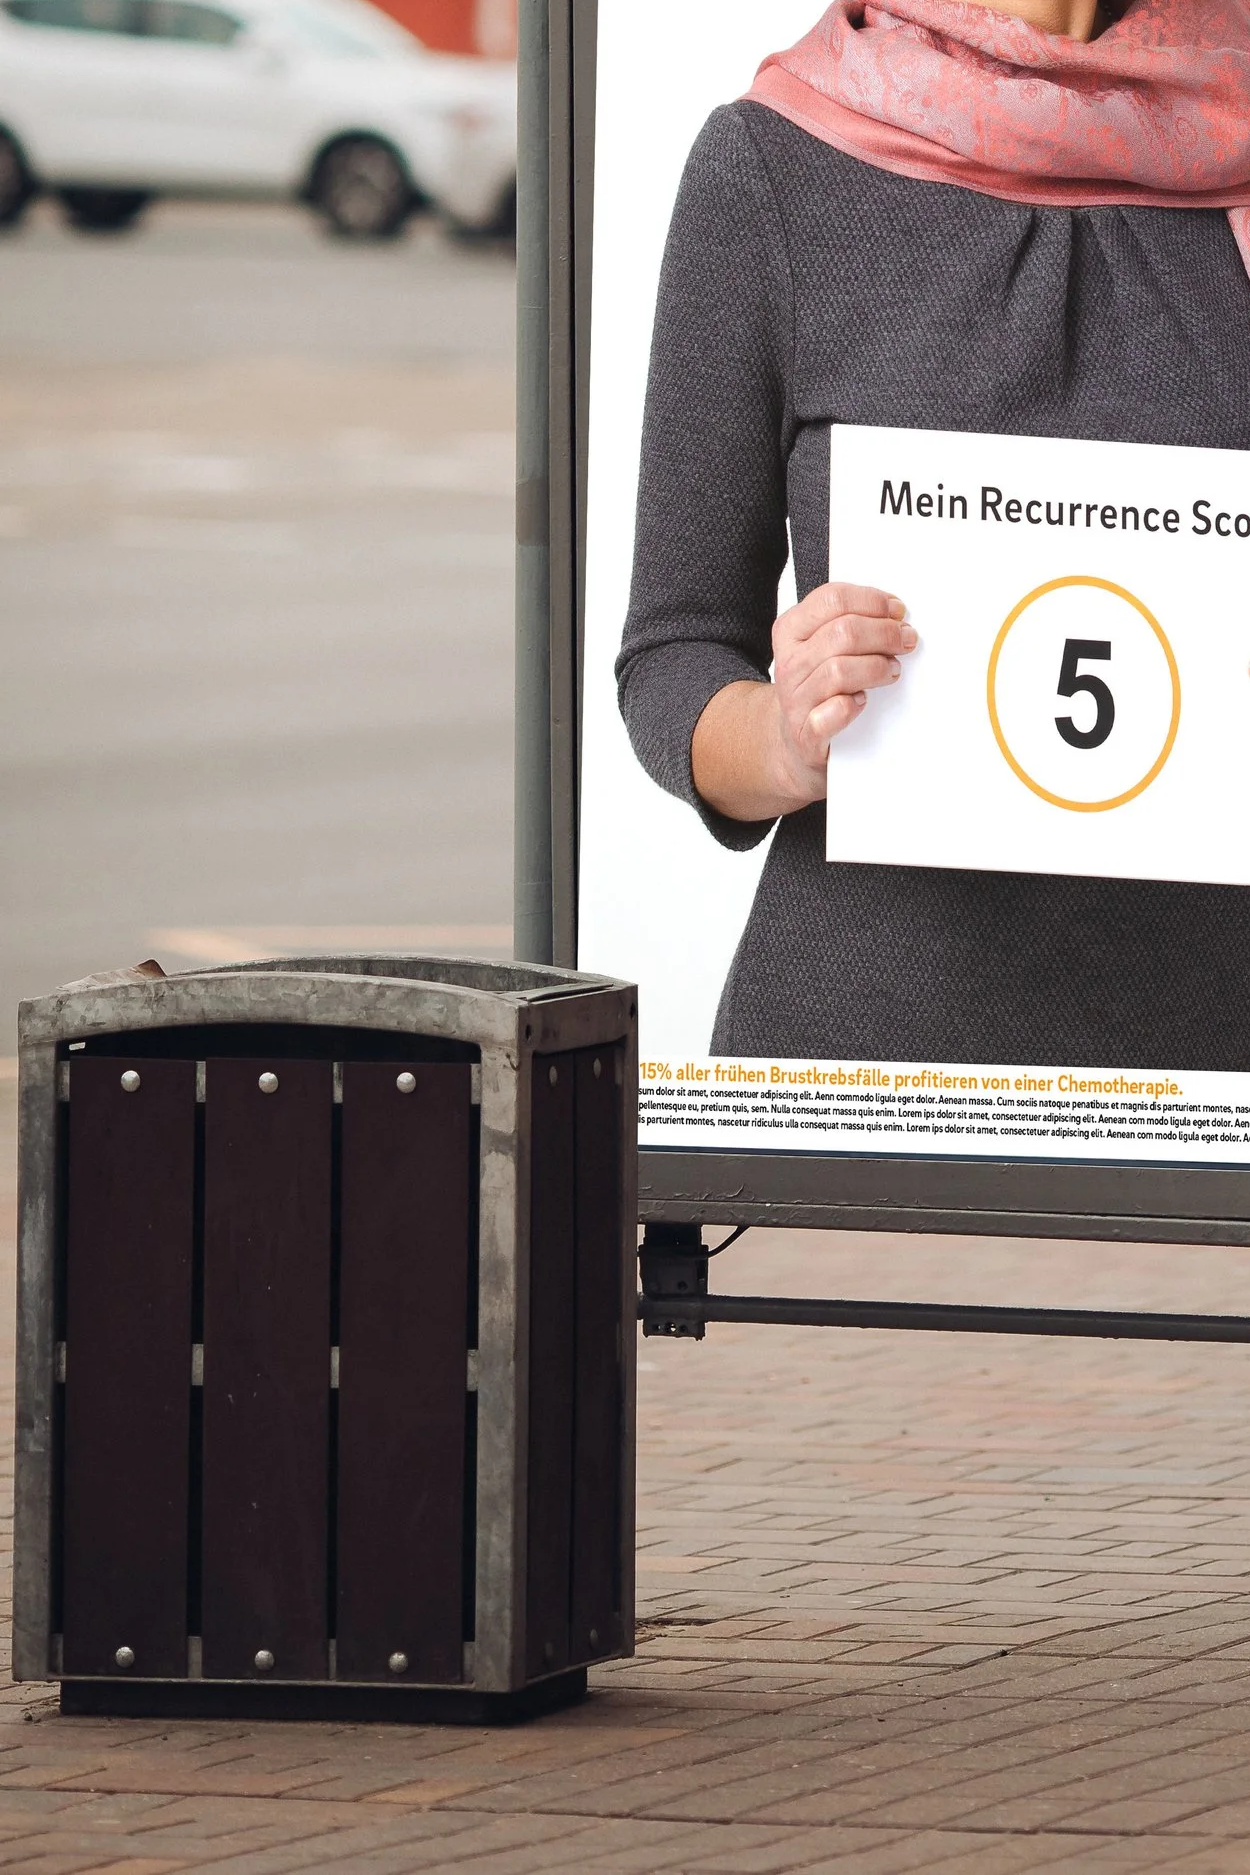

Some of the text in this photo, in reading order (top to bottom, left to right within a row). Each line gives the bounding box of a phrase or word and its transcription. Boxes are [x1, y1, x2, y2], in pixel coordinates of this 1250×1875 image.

[879, 479, 968, 520] Mein
[981, 486, 1180, 534] Recurrence
[1054, 638, 1116, 750] 5
[640, 1062, 1184, 1100] 15% aller frühen Brustkrebsfälle profitieren von einer Chemotherapie.
